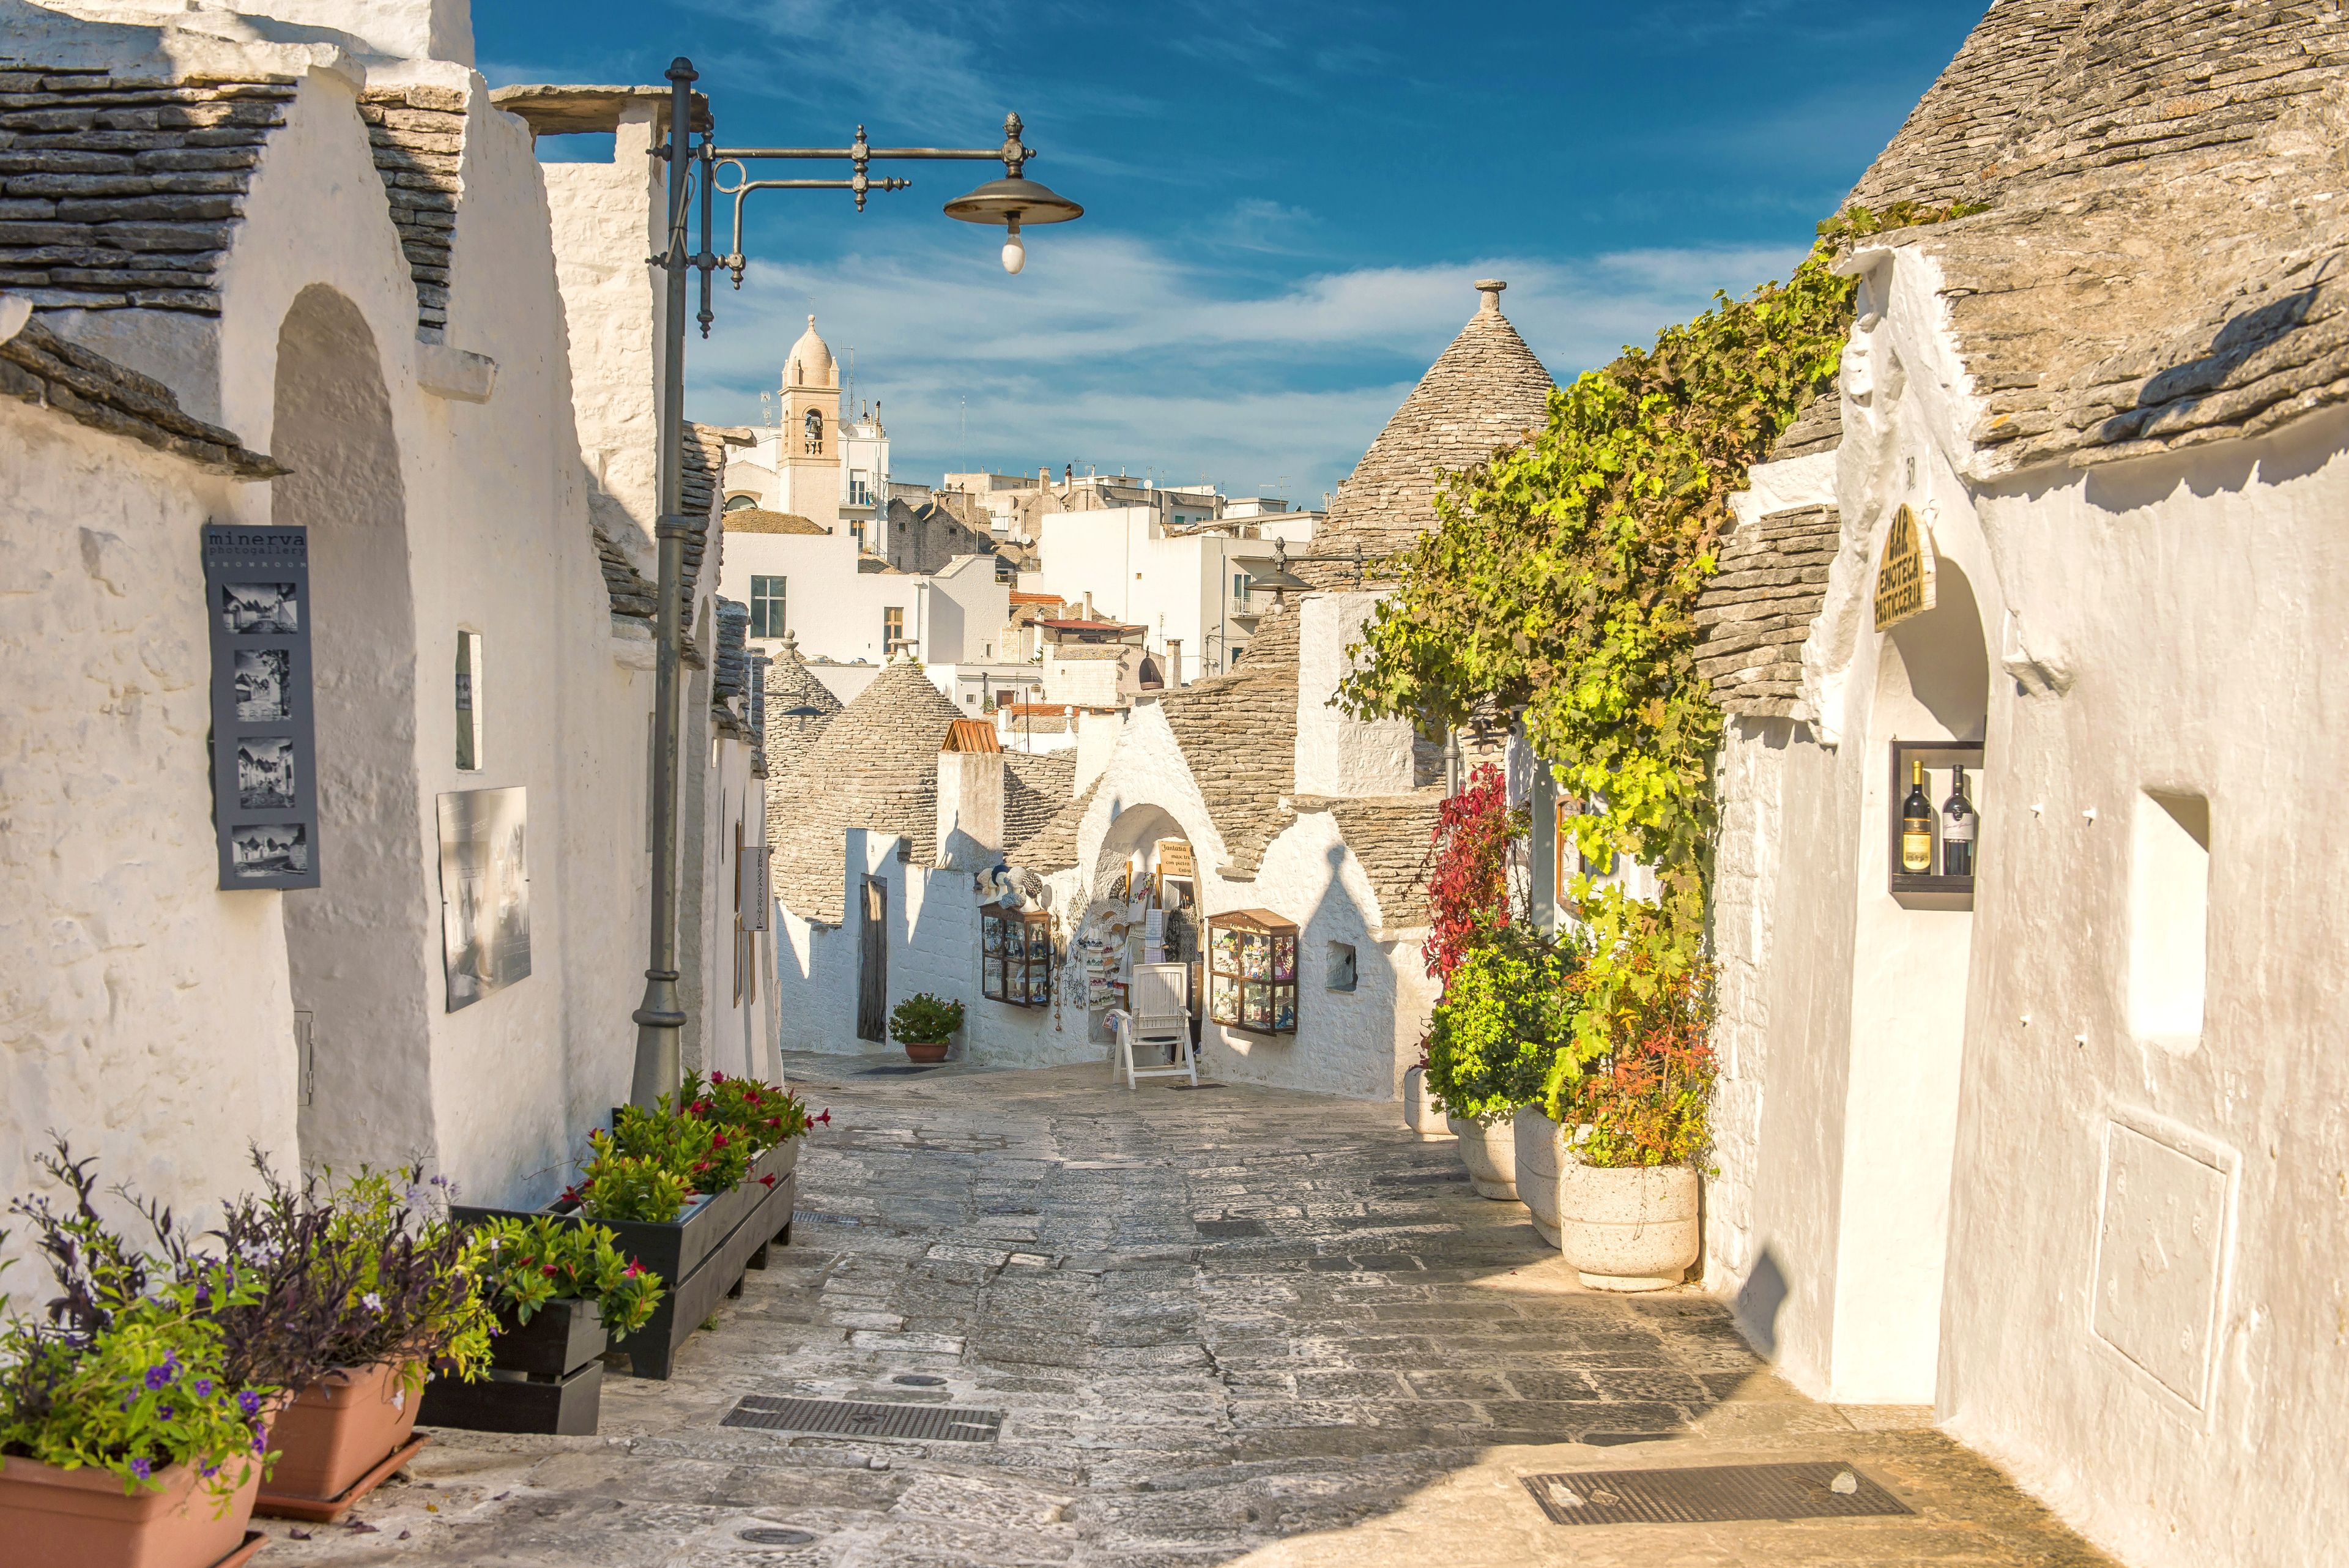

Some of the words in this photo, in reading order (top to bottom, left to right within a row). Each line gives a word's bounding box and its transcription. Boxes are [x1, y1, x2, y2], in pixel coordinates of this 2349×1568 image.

[209, 531, 305, 546] minerva
[209, 546, 305, 555] photogallery
[1890, 508, 1907, 561] BAR
[1880, 552, 1918, 594] ENOTECA
[1875, 581, 1921, 625] PASTICCERIA
